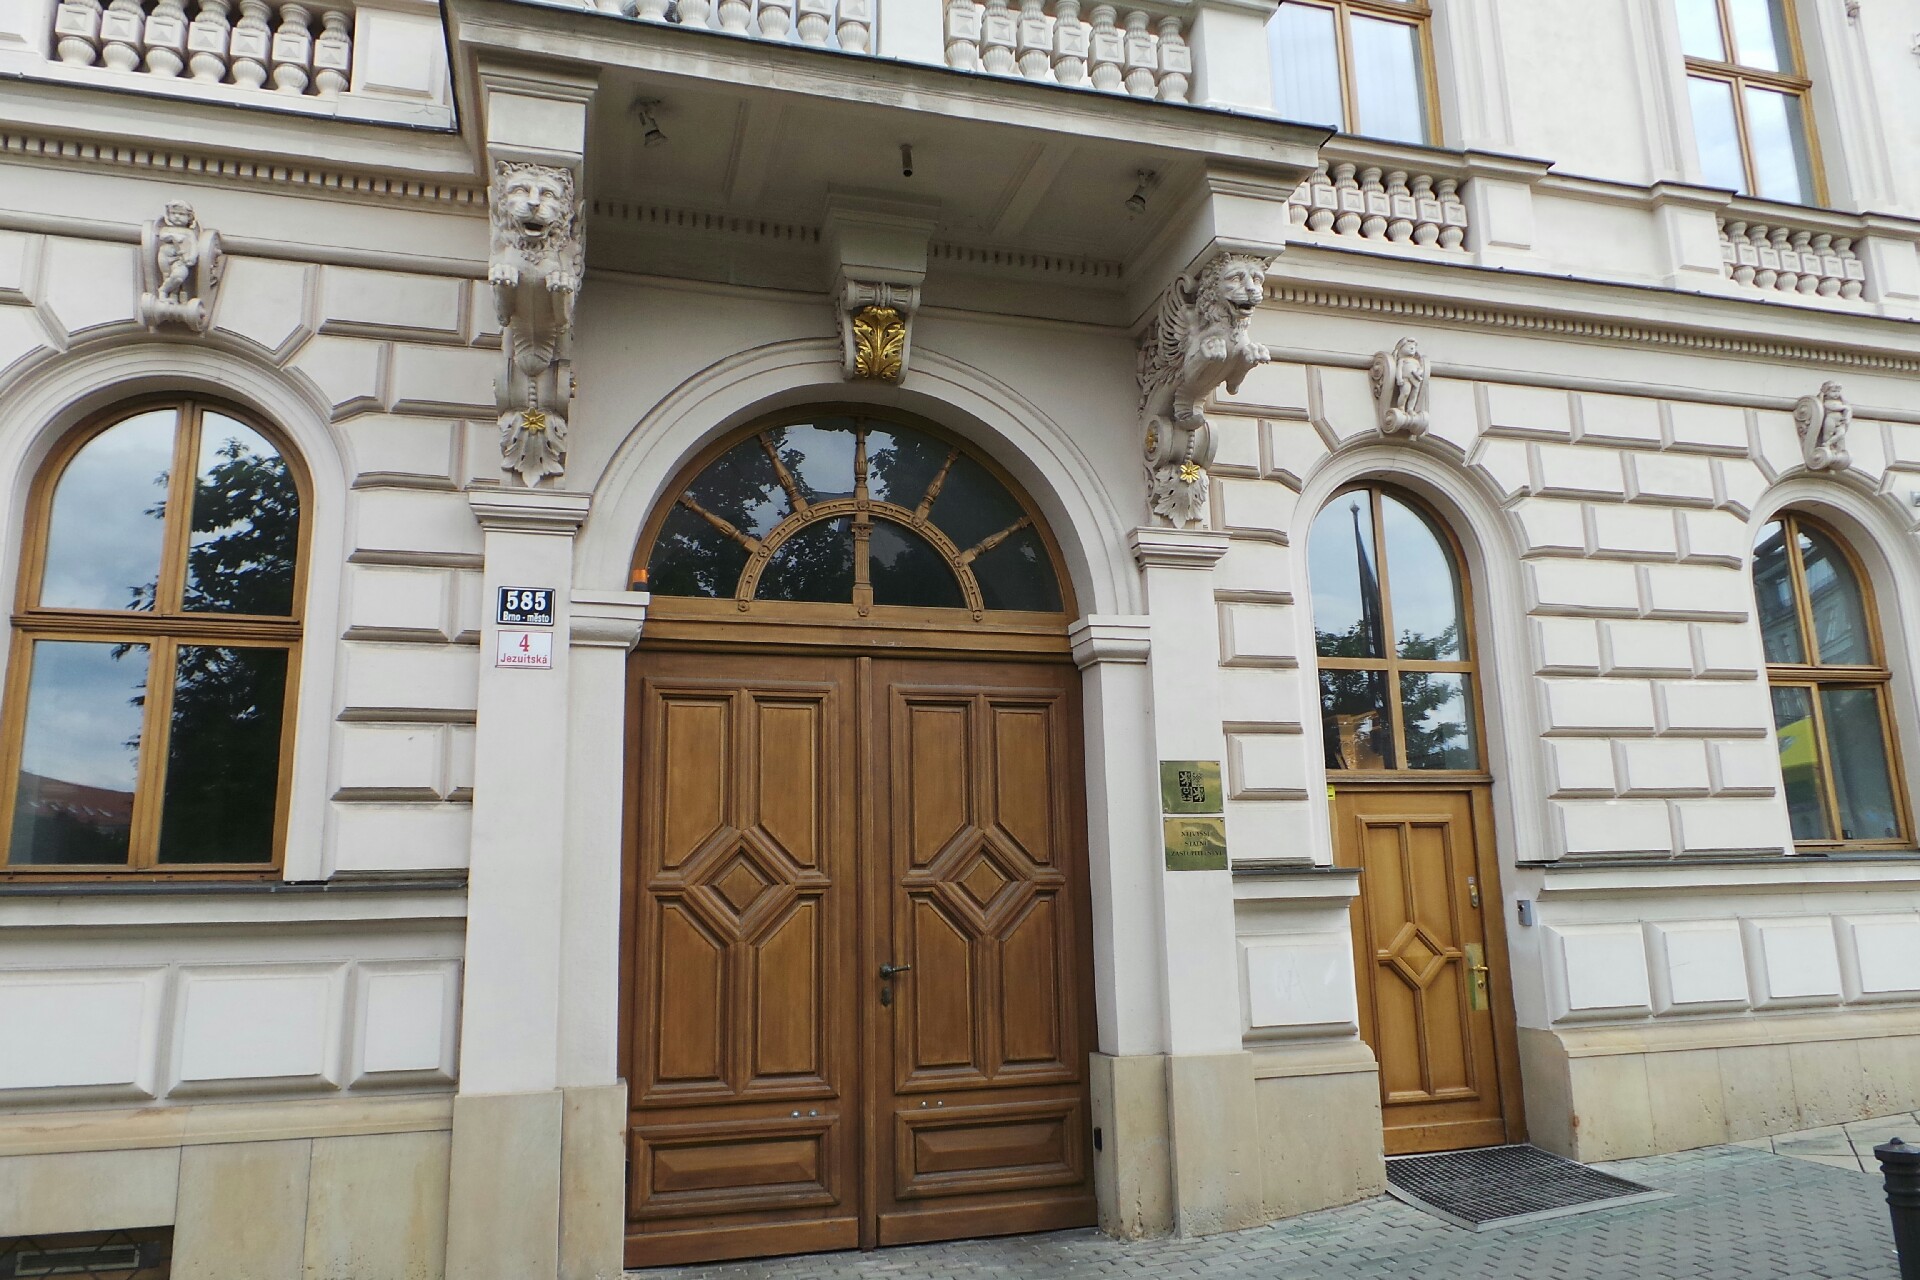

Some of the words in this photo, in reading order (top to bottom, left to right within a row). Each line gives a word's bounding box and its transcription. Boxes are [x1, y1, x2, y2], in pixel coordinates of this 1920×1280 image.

[506, 591, 546, 611] 585
[503, 611, 520, 621] Brno
[519, 634, 530, 652] 4
[500, 653, 548, 664] Jezuitská
